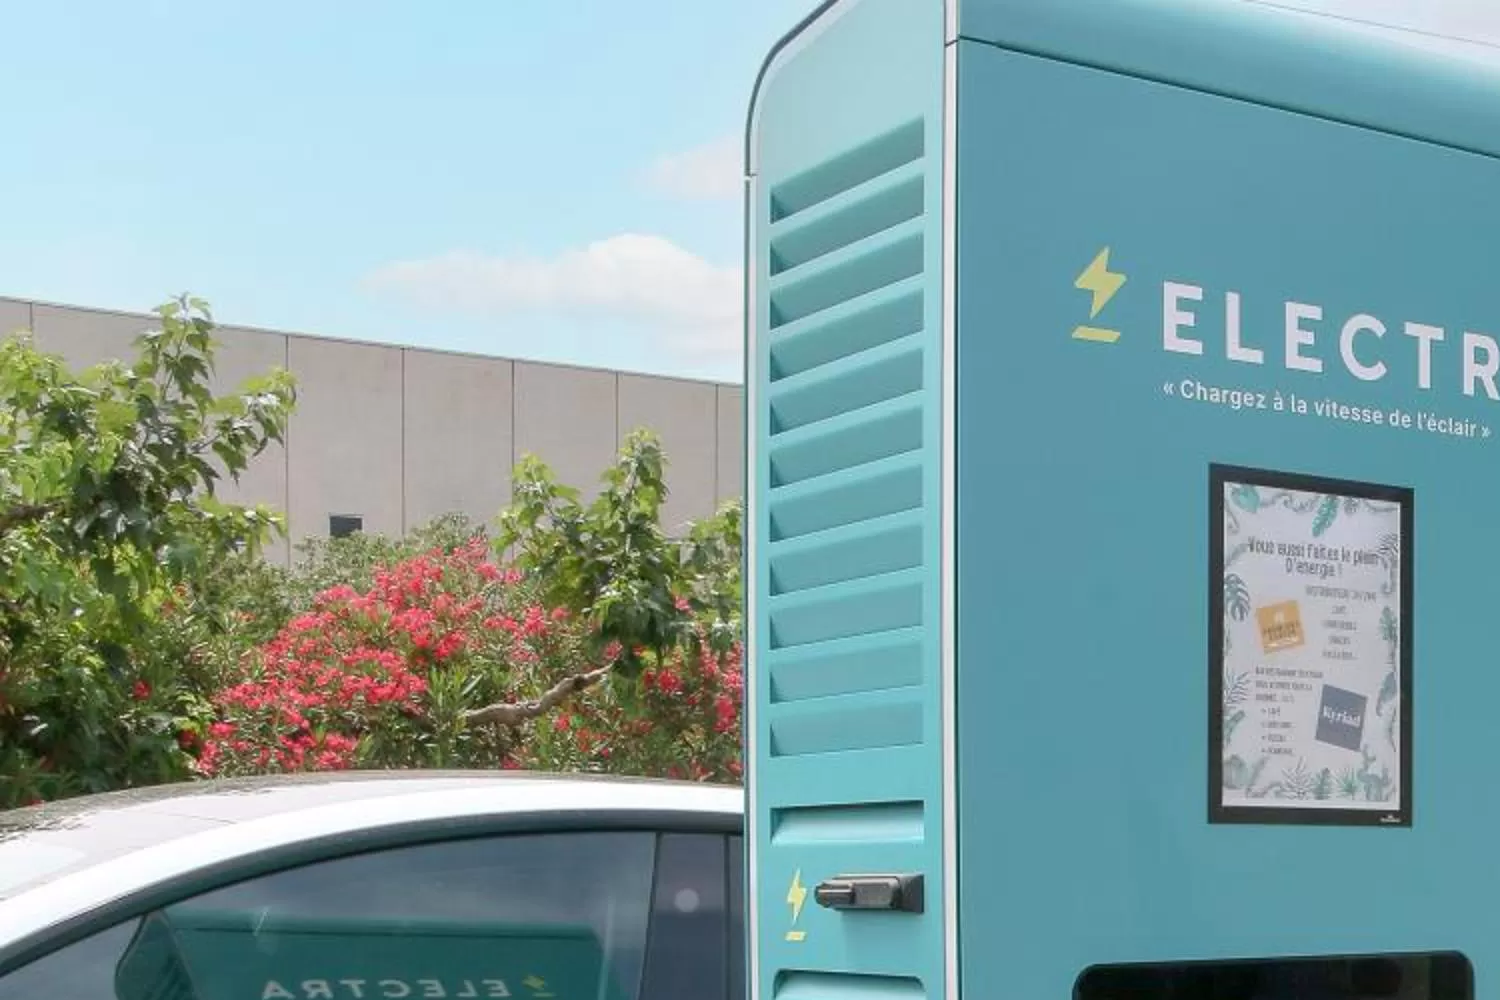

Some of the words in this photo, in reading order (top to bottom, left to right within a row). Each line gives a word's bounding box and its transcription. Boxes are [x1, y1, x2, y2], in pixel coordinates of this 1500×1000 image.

[1180, 380, 1267, 409] Chargez
[1273, 390, 1284, 411] à
[1290, 394, 1308, 416] la
[1314, 399, 1387, 426] vitesse
[1389, 409, 1413, 429] de
[1417, 411, 1477, 438] l'éclair
[1248, 537, 1274, 553] Vous
